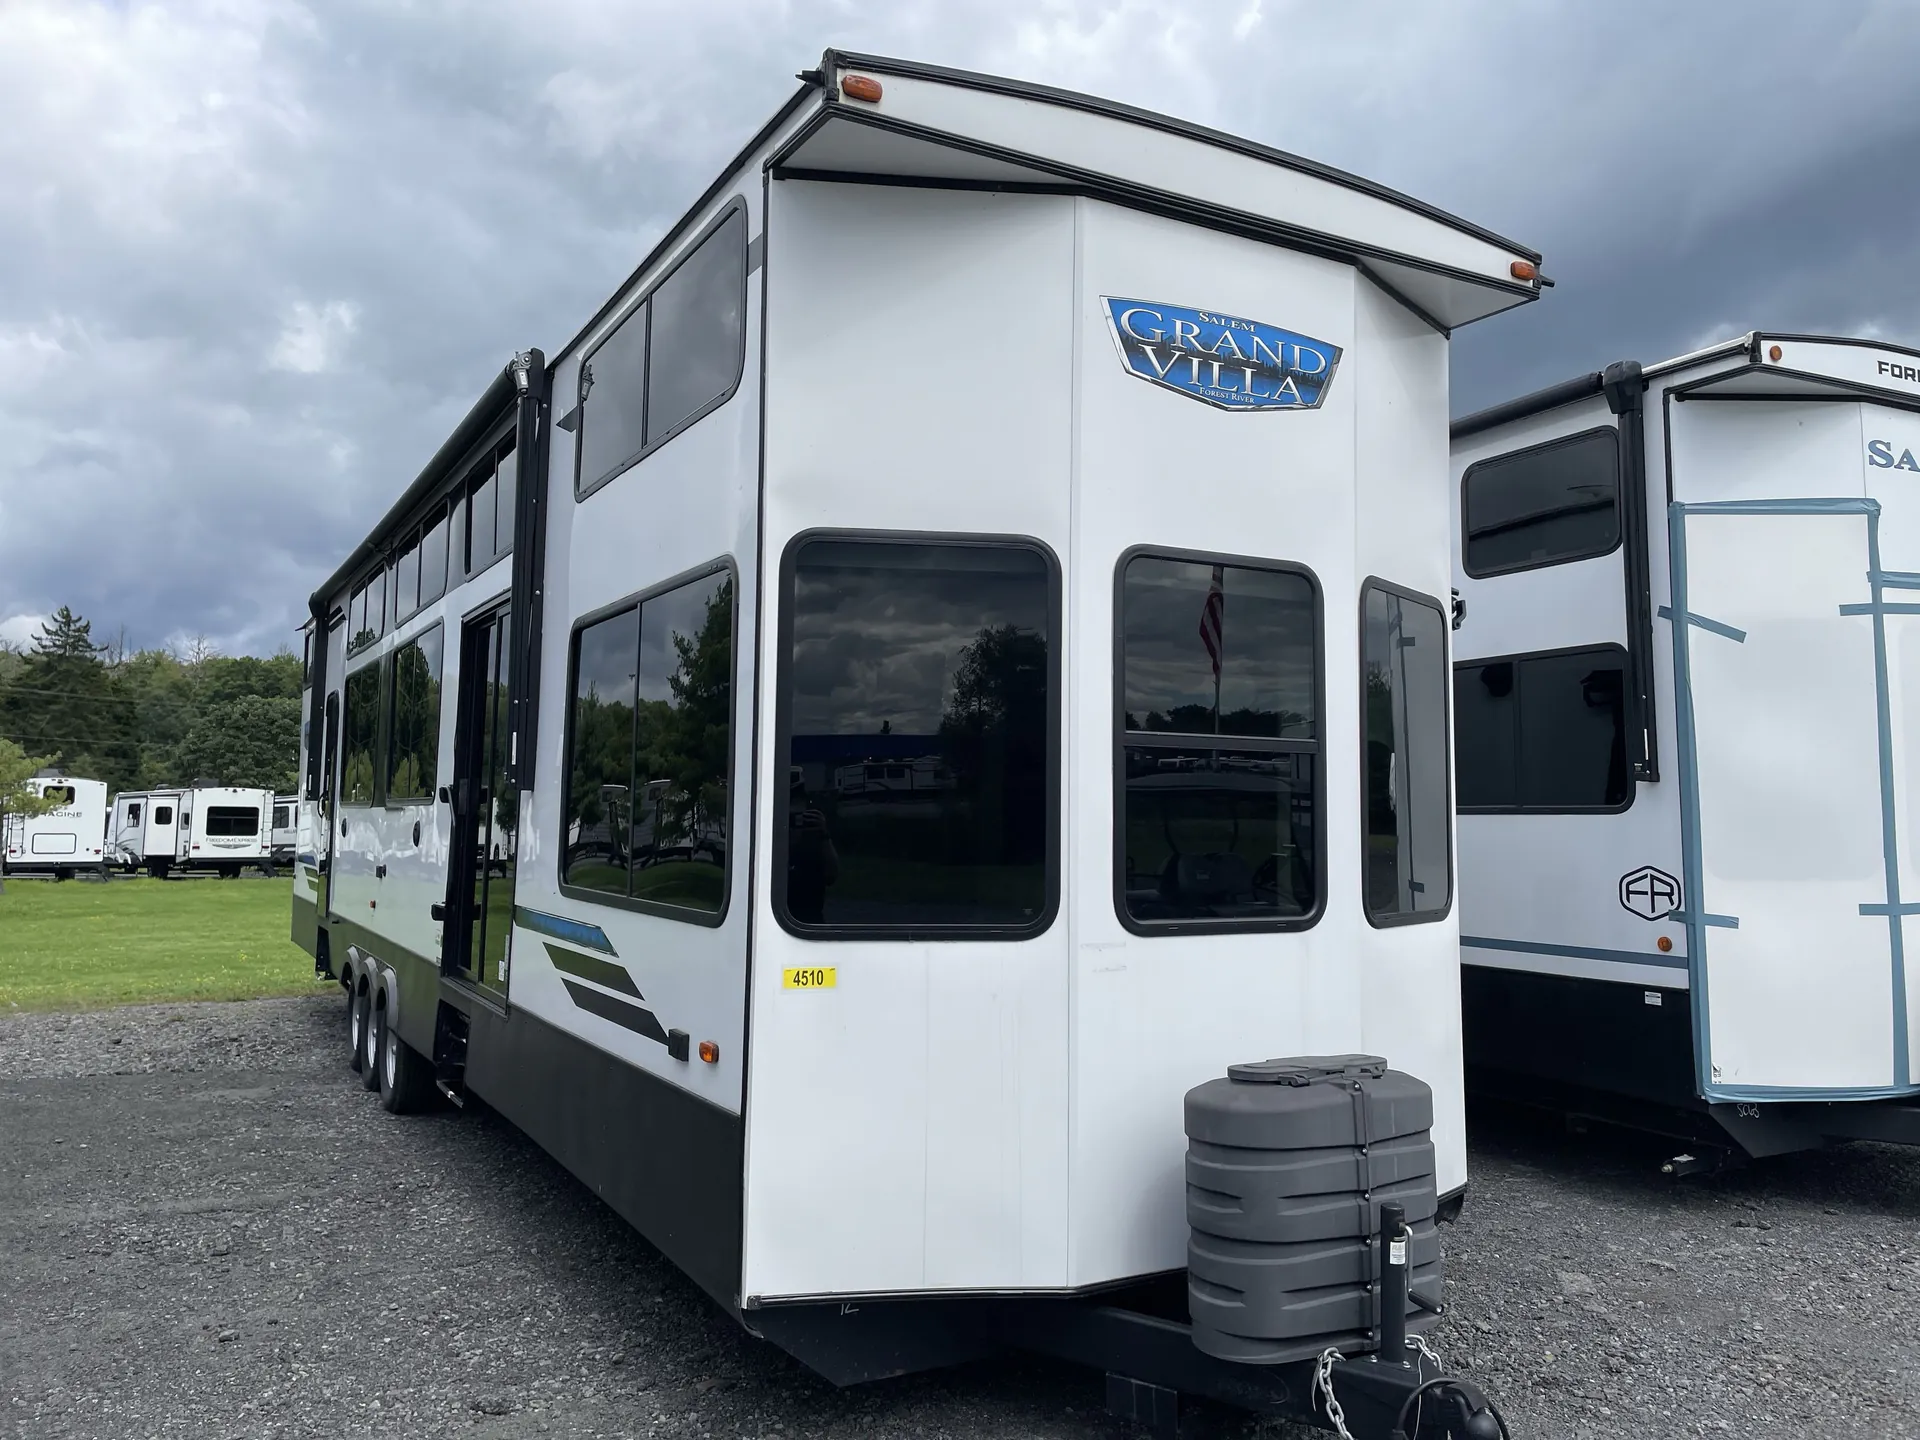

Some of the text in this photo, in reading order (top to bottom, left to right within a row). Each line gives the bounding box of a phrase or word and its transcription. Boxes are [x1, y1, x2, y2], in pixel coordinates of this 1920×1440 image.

[1198, 312, 1256, 333] SALEM
[1120, 308, 1327, 374] GRAND
[1138, 343, 1306, 404] VILLA
[1877, 360, 1920, 382] FOR
[1199, 386, 1255, 404] FOREST RIVER
[793, 969, 824, 986] 4510
